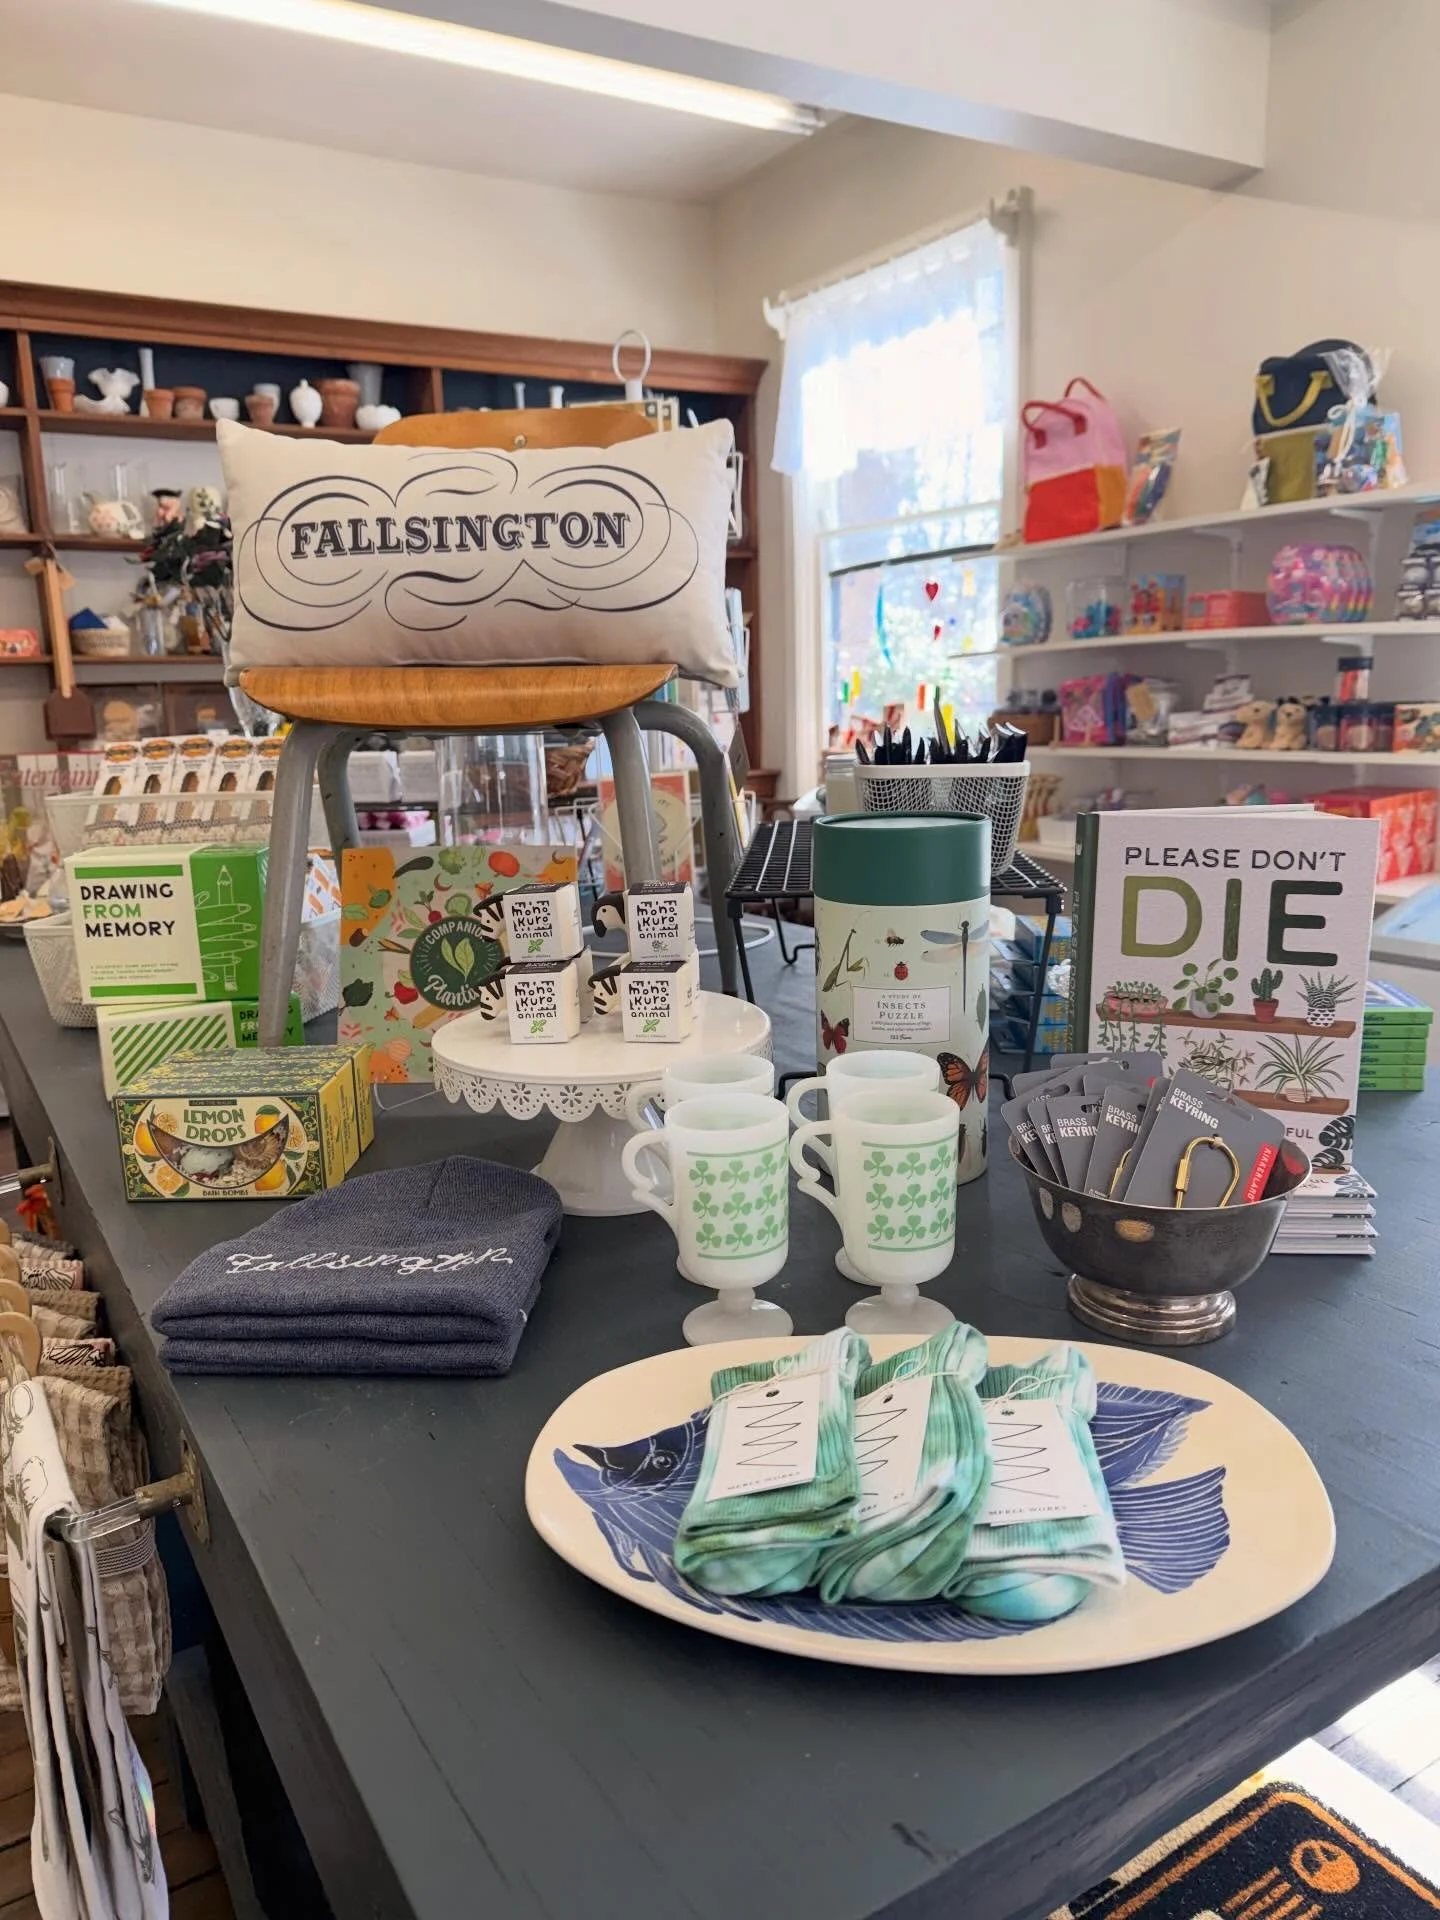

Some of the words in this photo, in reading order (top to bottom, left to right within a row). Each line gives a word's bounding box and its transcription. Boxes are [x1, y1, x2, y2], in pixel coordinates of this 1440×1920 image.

[291, 511, 630, 559] FALLSINGTON
[1125, 847, 1240, 868] PLEASE
[1251, 850, 1346, 871] DON'T
[80, 883, 173, 900] DRAWING
[83, 903, 142, 919] FROM
[85, 921, 175, 937] MEMORY
[1121, 875, 1343, 966] DIE
[425, 921, 485, 944] COMPANIO
[515, 930, 553, 939] animal
[639, 930, 679, 939] animal
[517, 1010, 557, 1019] animal
[631, 1010, 670, 1019] animal
[879, 1011, 924, 1019] PUZZLE
[1173, 1087, 1203, 1109] BRASS
[184, 1108, 245, 1124] LEMON
[1107, 1105, 1137, 1122] BRASS
[1169, 1095, 1219, 1129] KEYRING
[1057, 1117, 1088, 1127] BRASS
[1105, 1112, 1141, 1133] KEYRI
[186, 1125, 247, 1142] DROPS
[1286, 1127, 1314, 1139] FUL
[1247, 1146, 1272, 1201] KIKKERLAND
